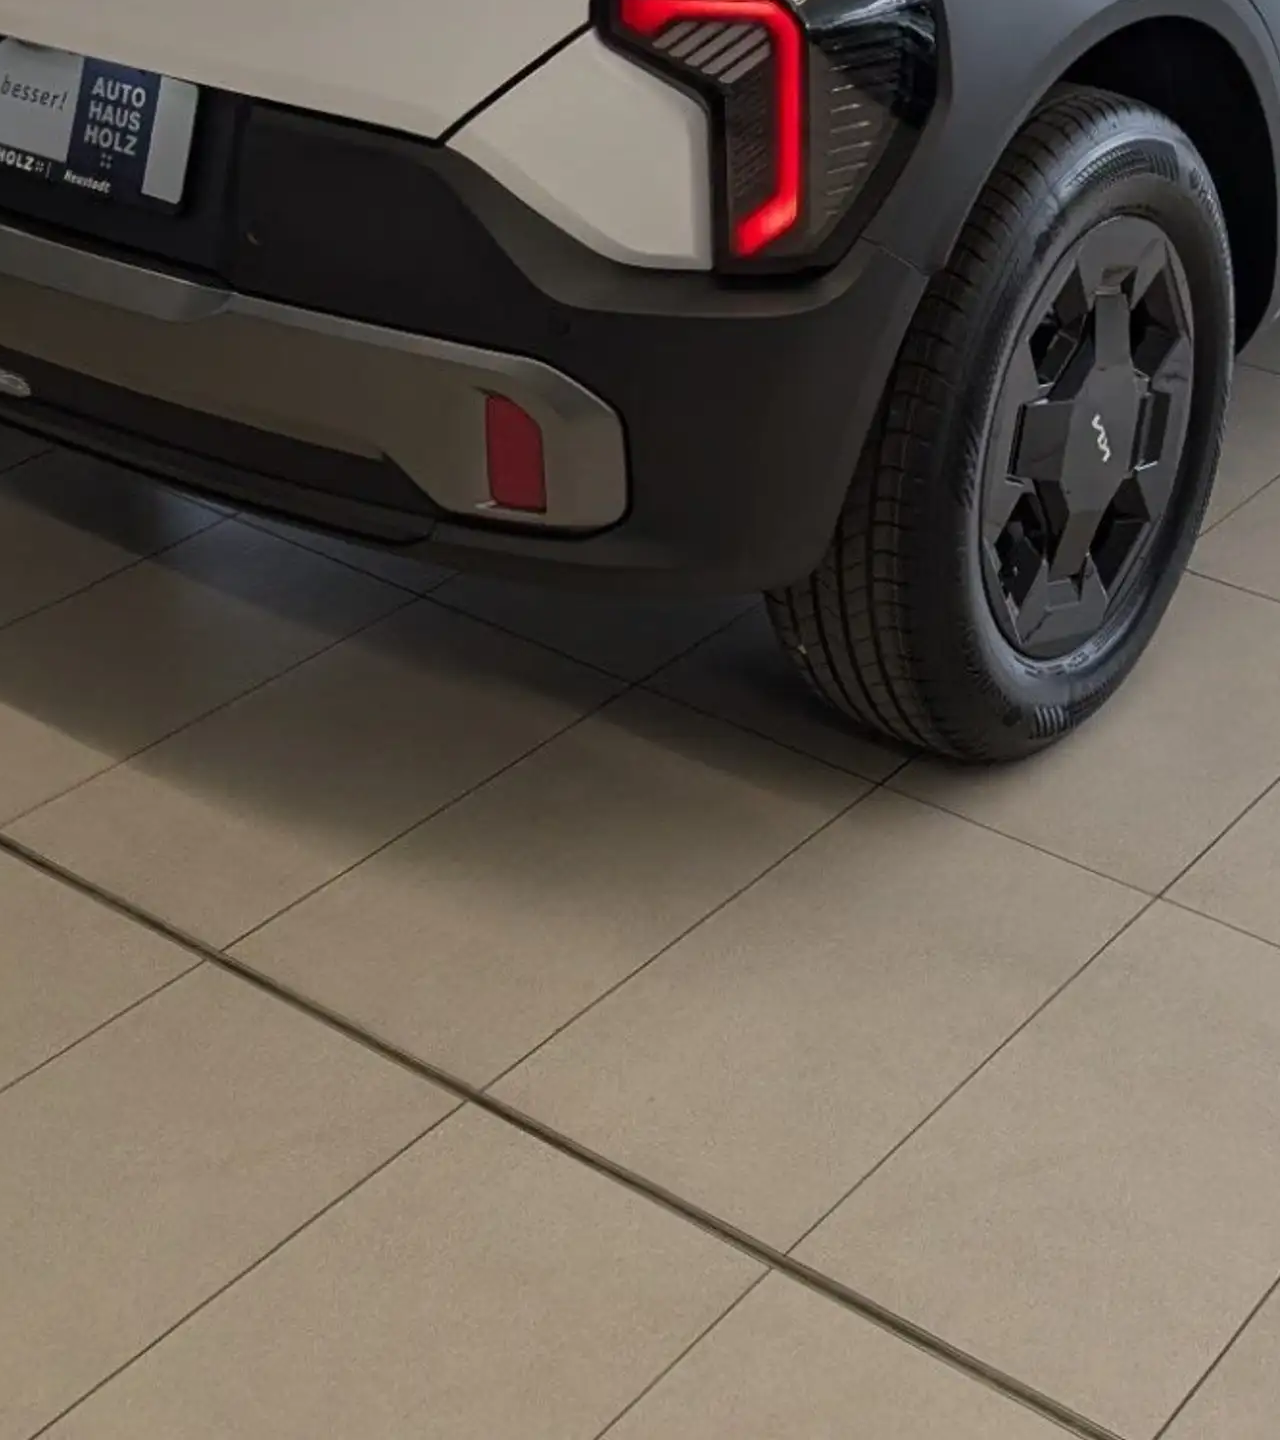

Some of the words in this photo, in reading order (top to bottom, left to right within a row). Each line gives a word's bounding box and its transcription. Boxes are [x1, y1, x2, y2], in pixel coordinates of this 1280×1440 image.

[0, 74, 68, 111] besser!
[91, 76, 146, 108] AUTO
[88, 100, 142, 132] HAUS
[83, 124, 138, 156] HOLZ
[1091, 414, 1111, 463] KIA
